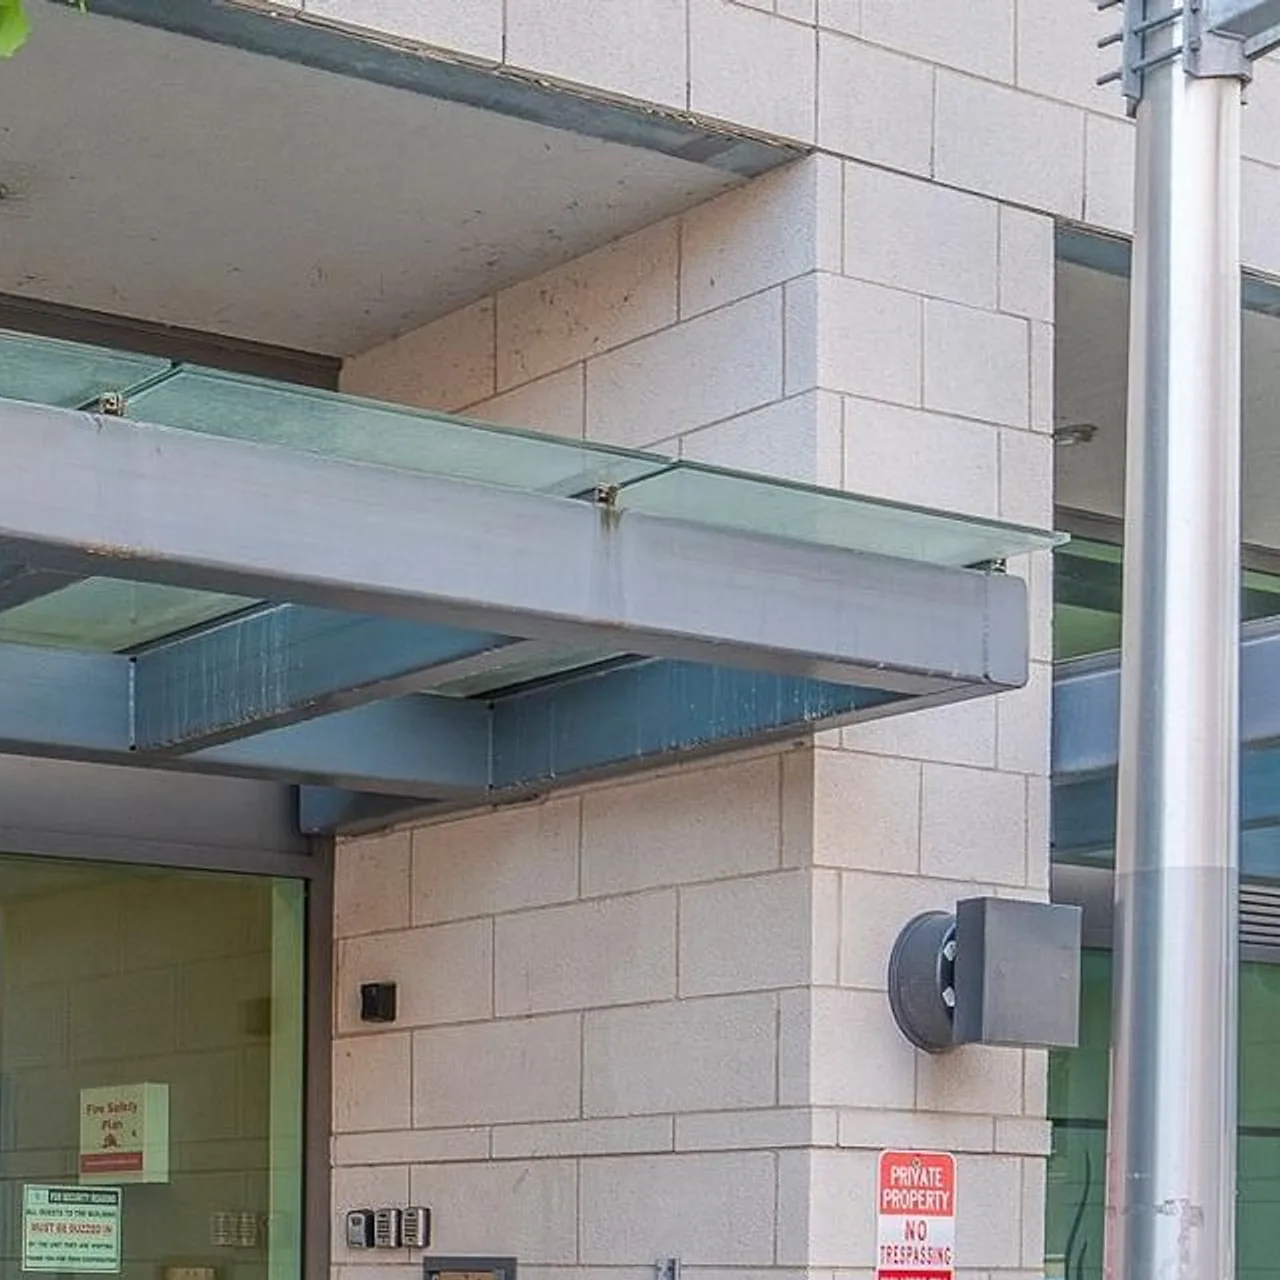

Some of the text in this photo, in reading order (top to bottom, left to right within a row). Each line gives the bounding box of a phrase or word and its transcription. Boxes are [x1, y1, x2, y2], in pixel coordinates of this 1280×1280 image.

[890, 1165, 943, 1187] PRIVATE
[881, 1188, 950, 1210] PROPERTY
[904, 1219, 927, 1241] NO
[880, 1245, 952, 1265] TRESPASSING
